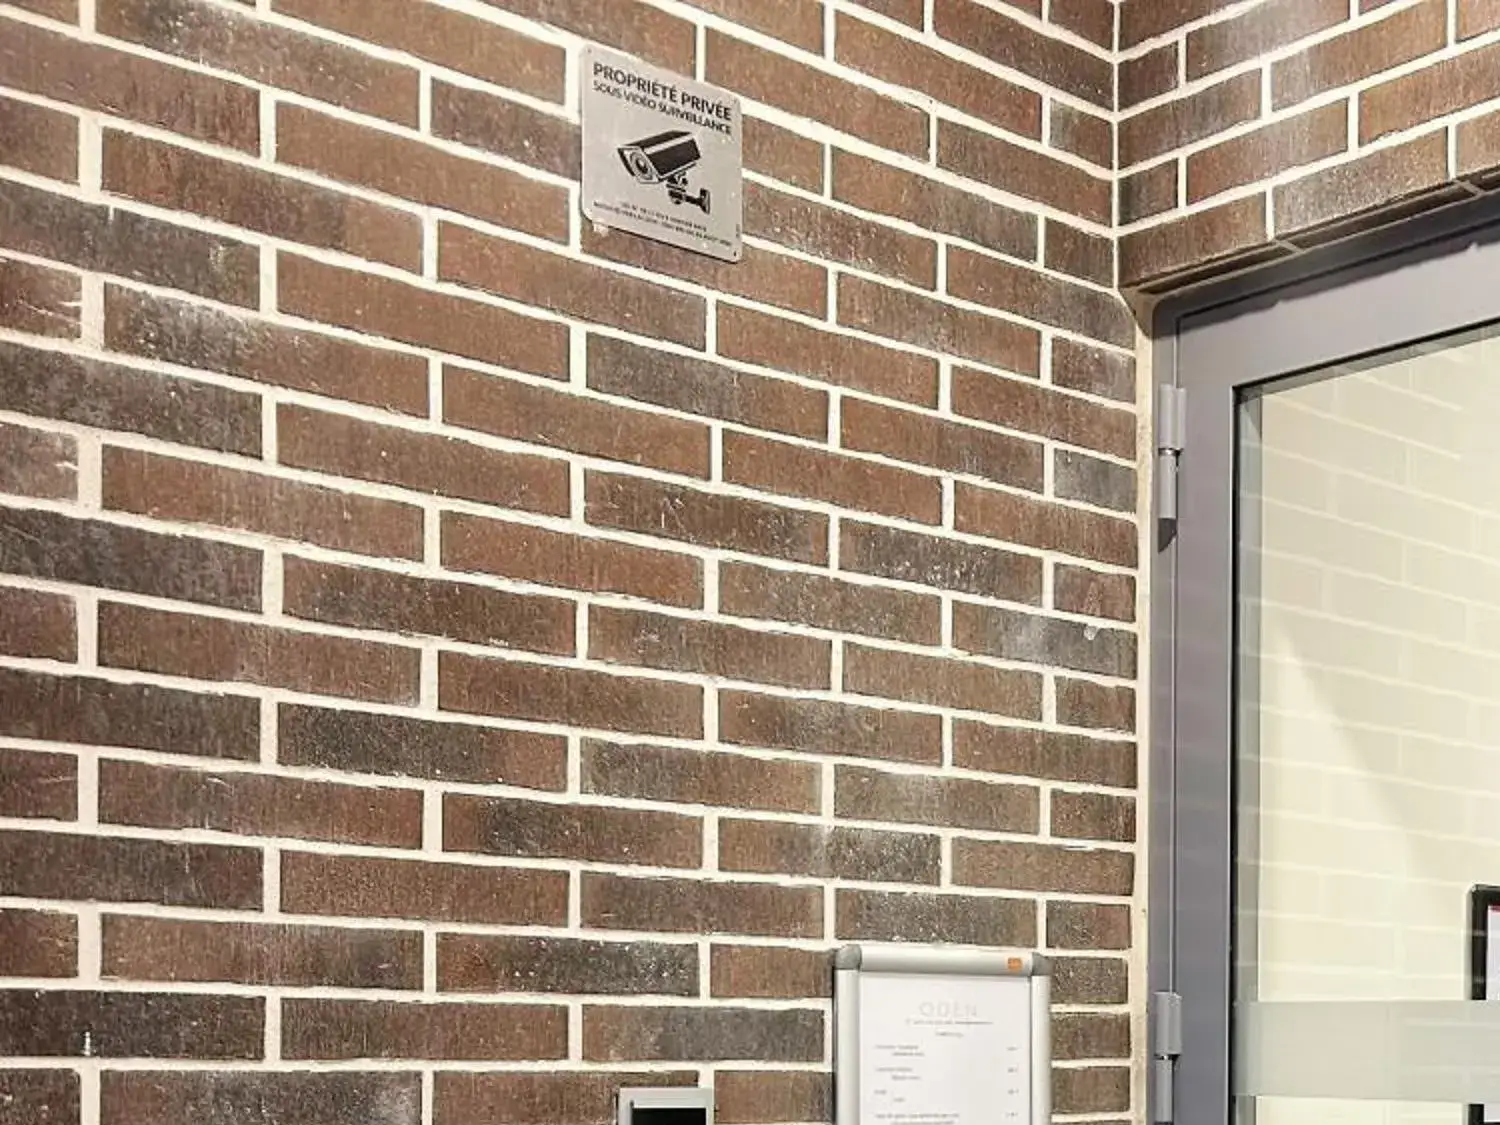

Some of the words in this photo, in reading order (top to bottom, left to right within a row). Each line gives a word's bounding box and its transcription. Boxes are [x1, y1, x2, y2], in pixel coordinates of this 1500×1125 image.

[592, 80, 622, 99] SOUS
[658, 102, 731, 135] SURVEILLANCE
[593, 62, 678, 103] PROPRIÉTÉ
[681, 91, 732, 121] PRIVÉE
